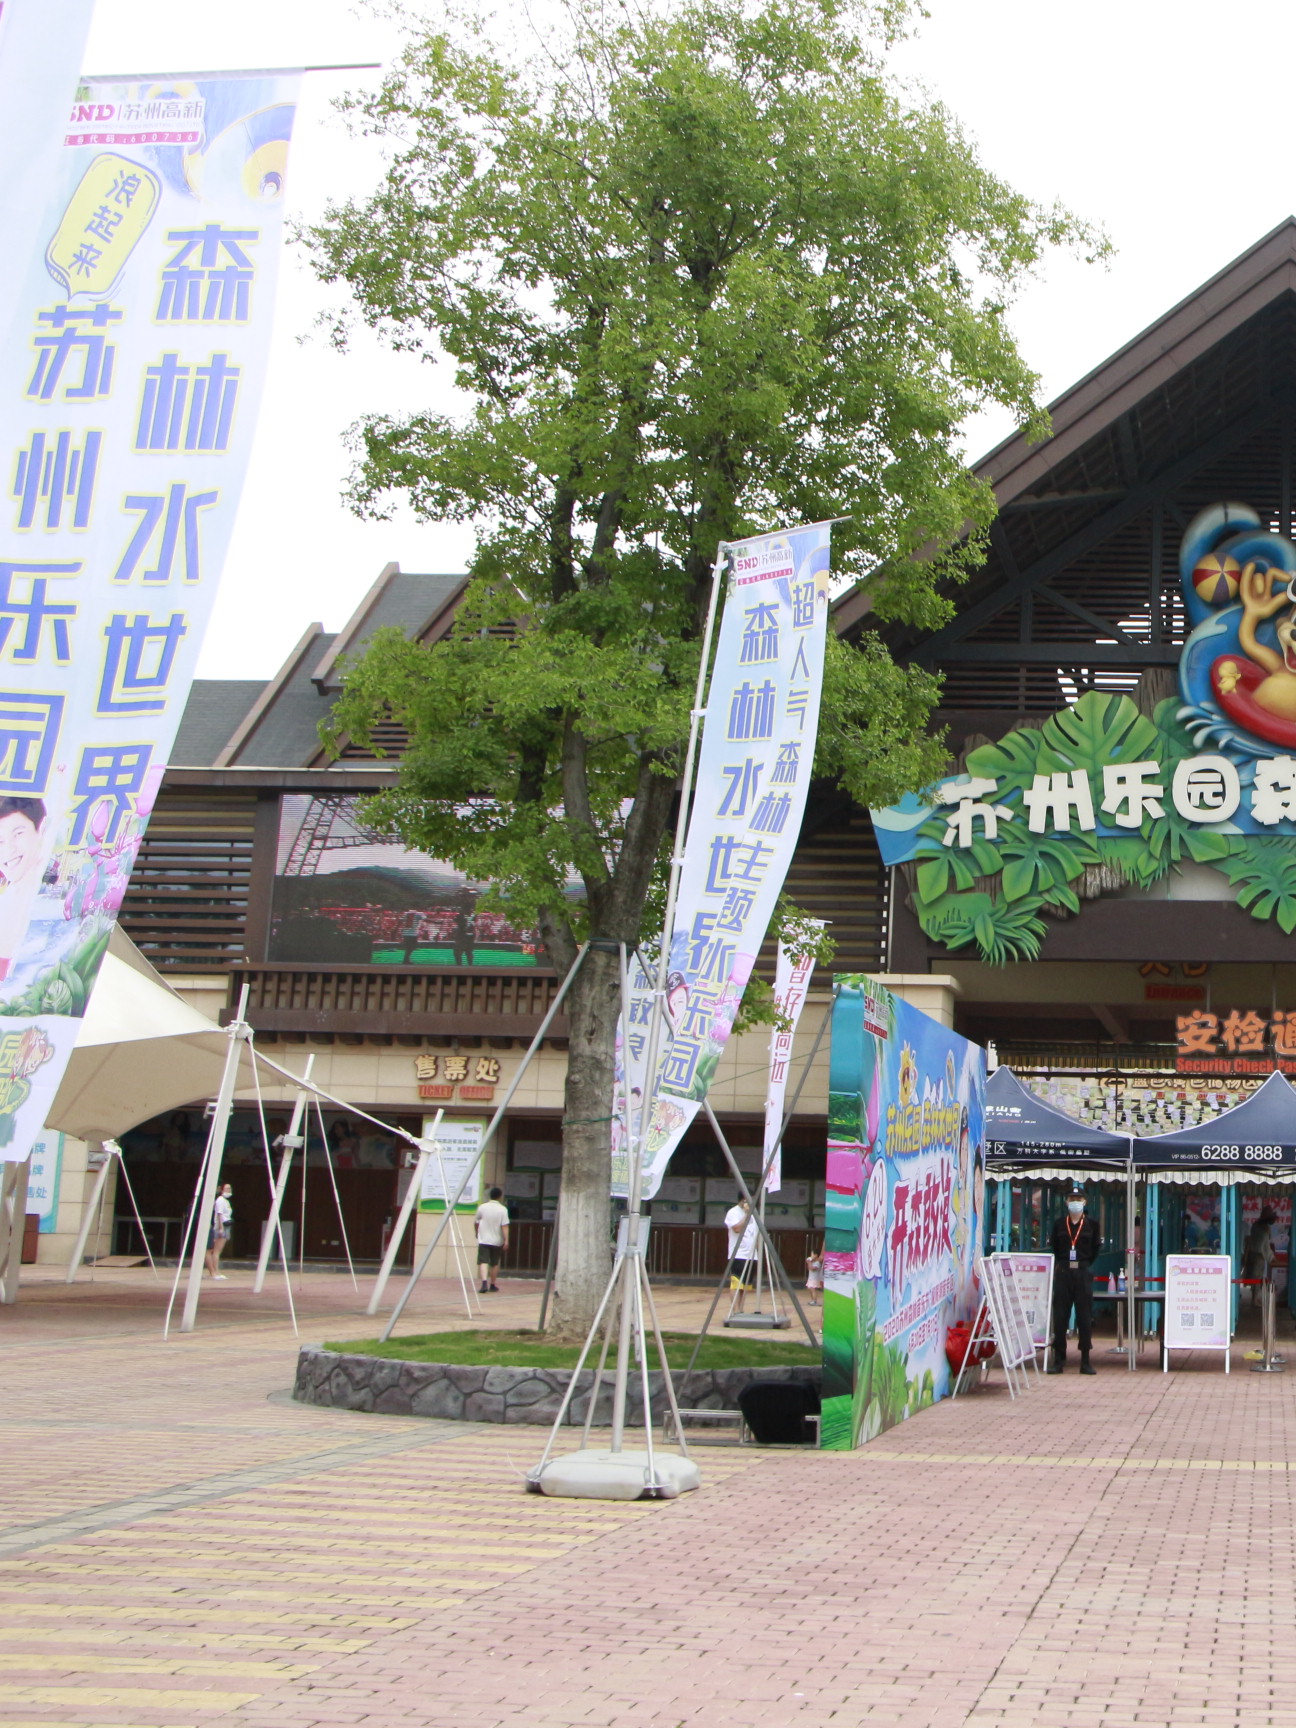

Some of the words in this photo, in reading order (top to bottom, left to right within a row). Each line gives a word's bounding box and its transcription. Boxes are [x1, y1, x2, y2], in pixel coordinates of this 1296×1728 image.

[124, 102, 203, 121] 苏州高新
[71, 171, 143, 279] 浪起来
[68, 224, 259, 848] 森林水世界
[737, 556, 759, 571] SND
[414, 1055, 499, 1082] 售票处
[1176, 1058, 1231, 1074] Security
[1234, 1058, 1274, 1073] Check
[418, 1085, 454, 1098] TICKET
[886, 1103, 922, 1157] 苏州乐园
[1201, 1145, 1240, 1160] 6288
[1244, 1145, 1283, 1161] 8888
[891, 1157, 953, 1313] 开森敢浪
